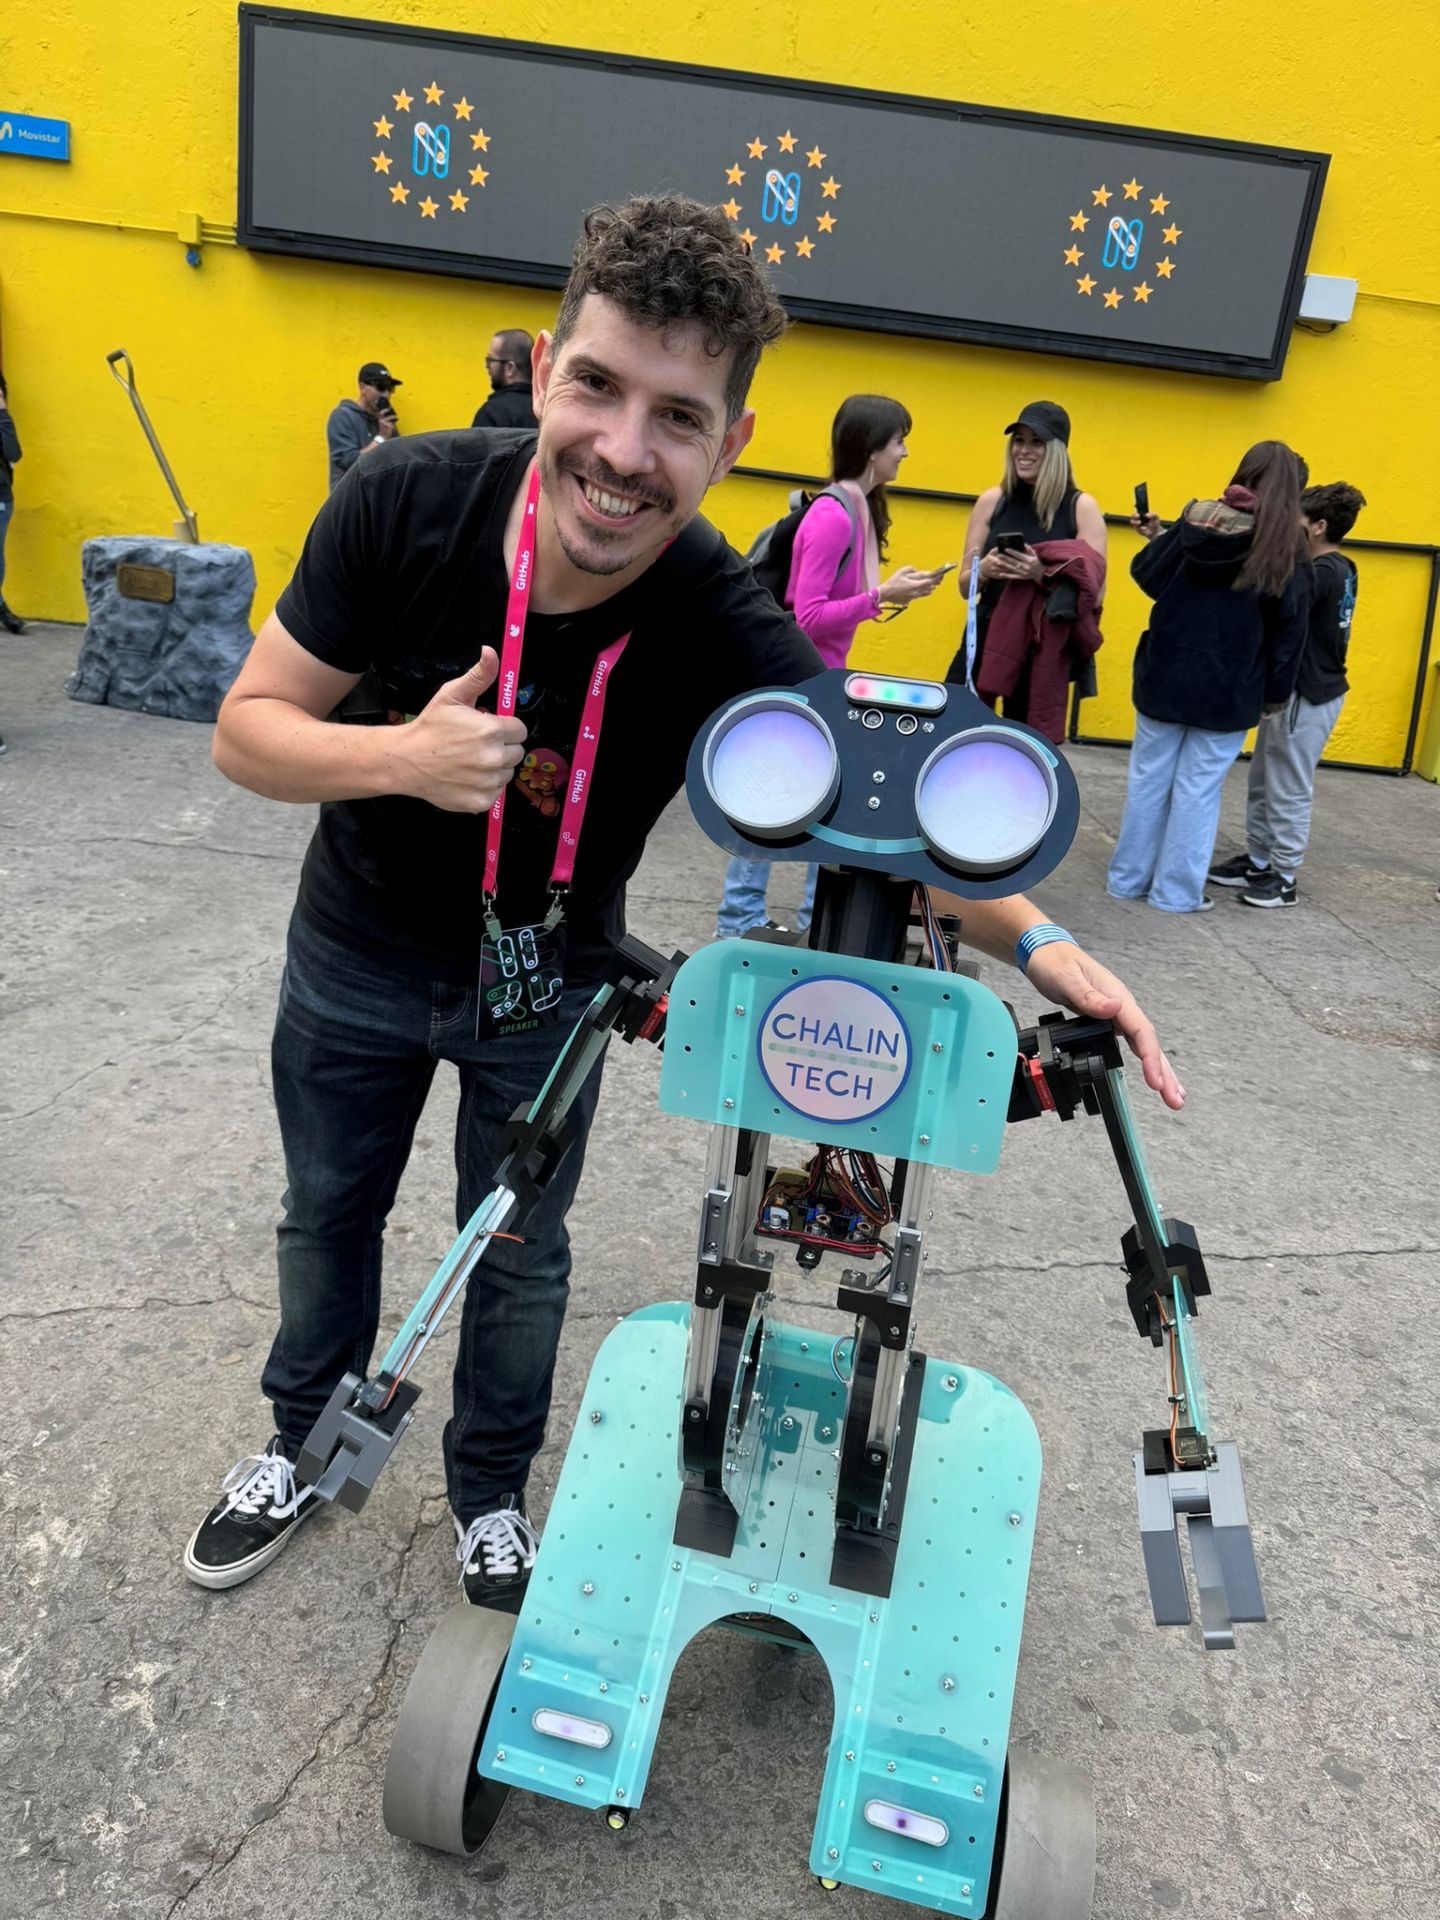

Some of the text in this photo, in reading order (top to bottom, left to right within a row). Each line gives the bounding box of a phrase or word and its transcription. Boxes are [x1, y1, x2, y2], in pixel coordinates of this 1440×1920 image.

[18, 129, 60, 143] Movistar
[516, 550, 530, 590] GitHub
[503, 671, 515, 708] GitHub
[592, 660, 607, 696] GitHub
[571, 769, 587, 803] GitHub
[499, 1019, 539, 1035] SPEAKER
[772, 1013, 899, 1058] CHALIN
[786, 1062, 873, 1100] TECH
